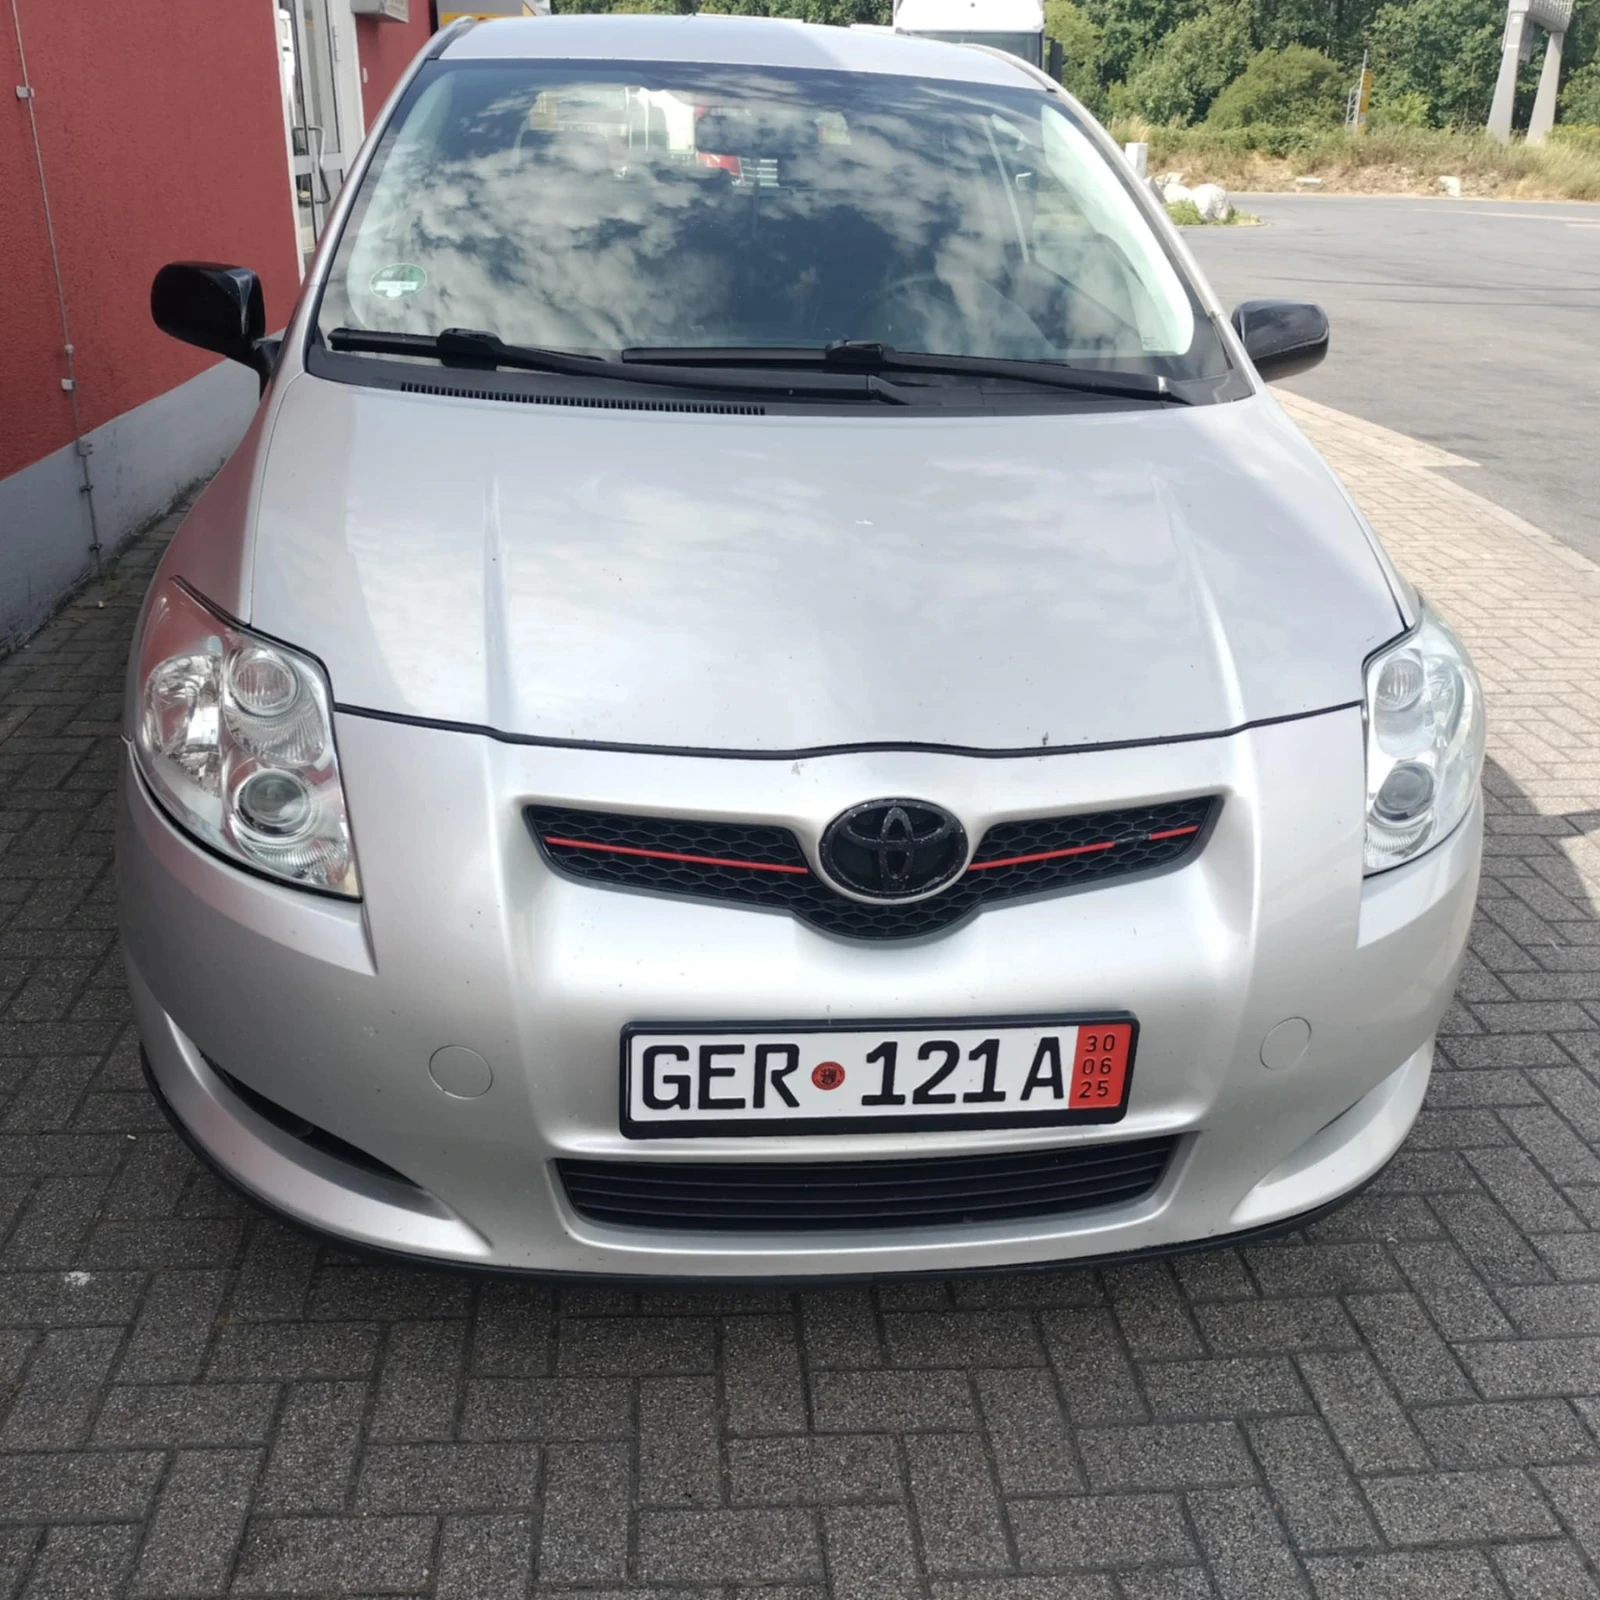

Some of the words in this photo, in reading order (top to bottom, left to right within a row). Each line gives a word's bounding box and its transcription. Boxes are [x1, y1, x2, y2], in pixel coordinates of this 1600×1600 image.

[1085, 1034, 1116, 1053] 30
[1082, 1057, 1112, 1076] 06
[642, 1043, 800, 1111] GER
[1079, 1080, 1109, 1099] 25
